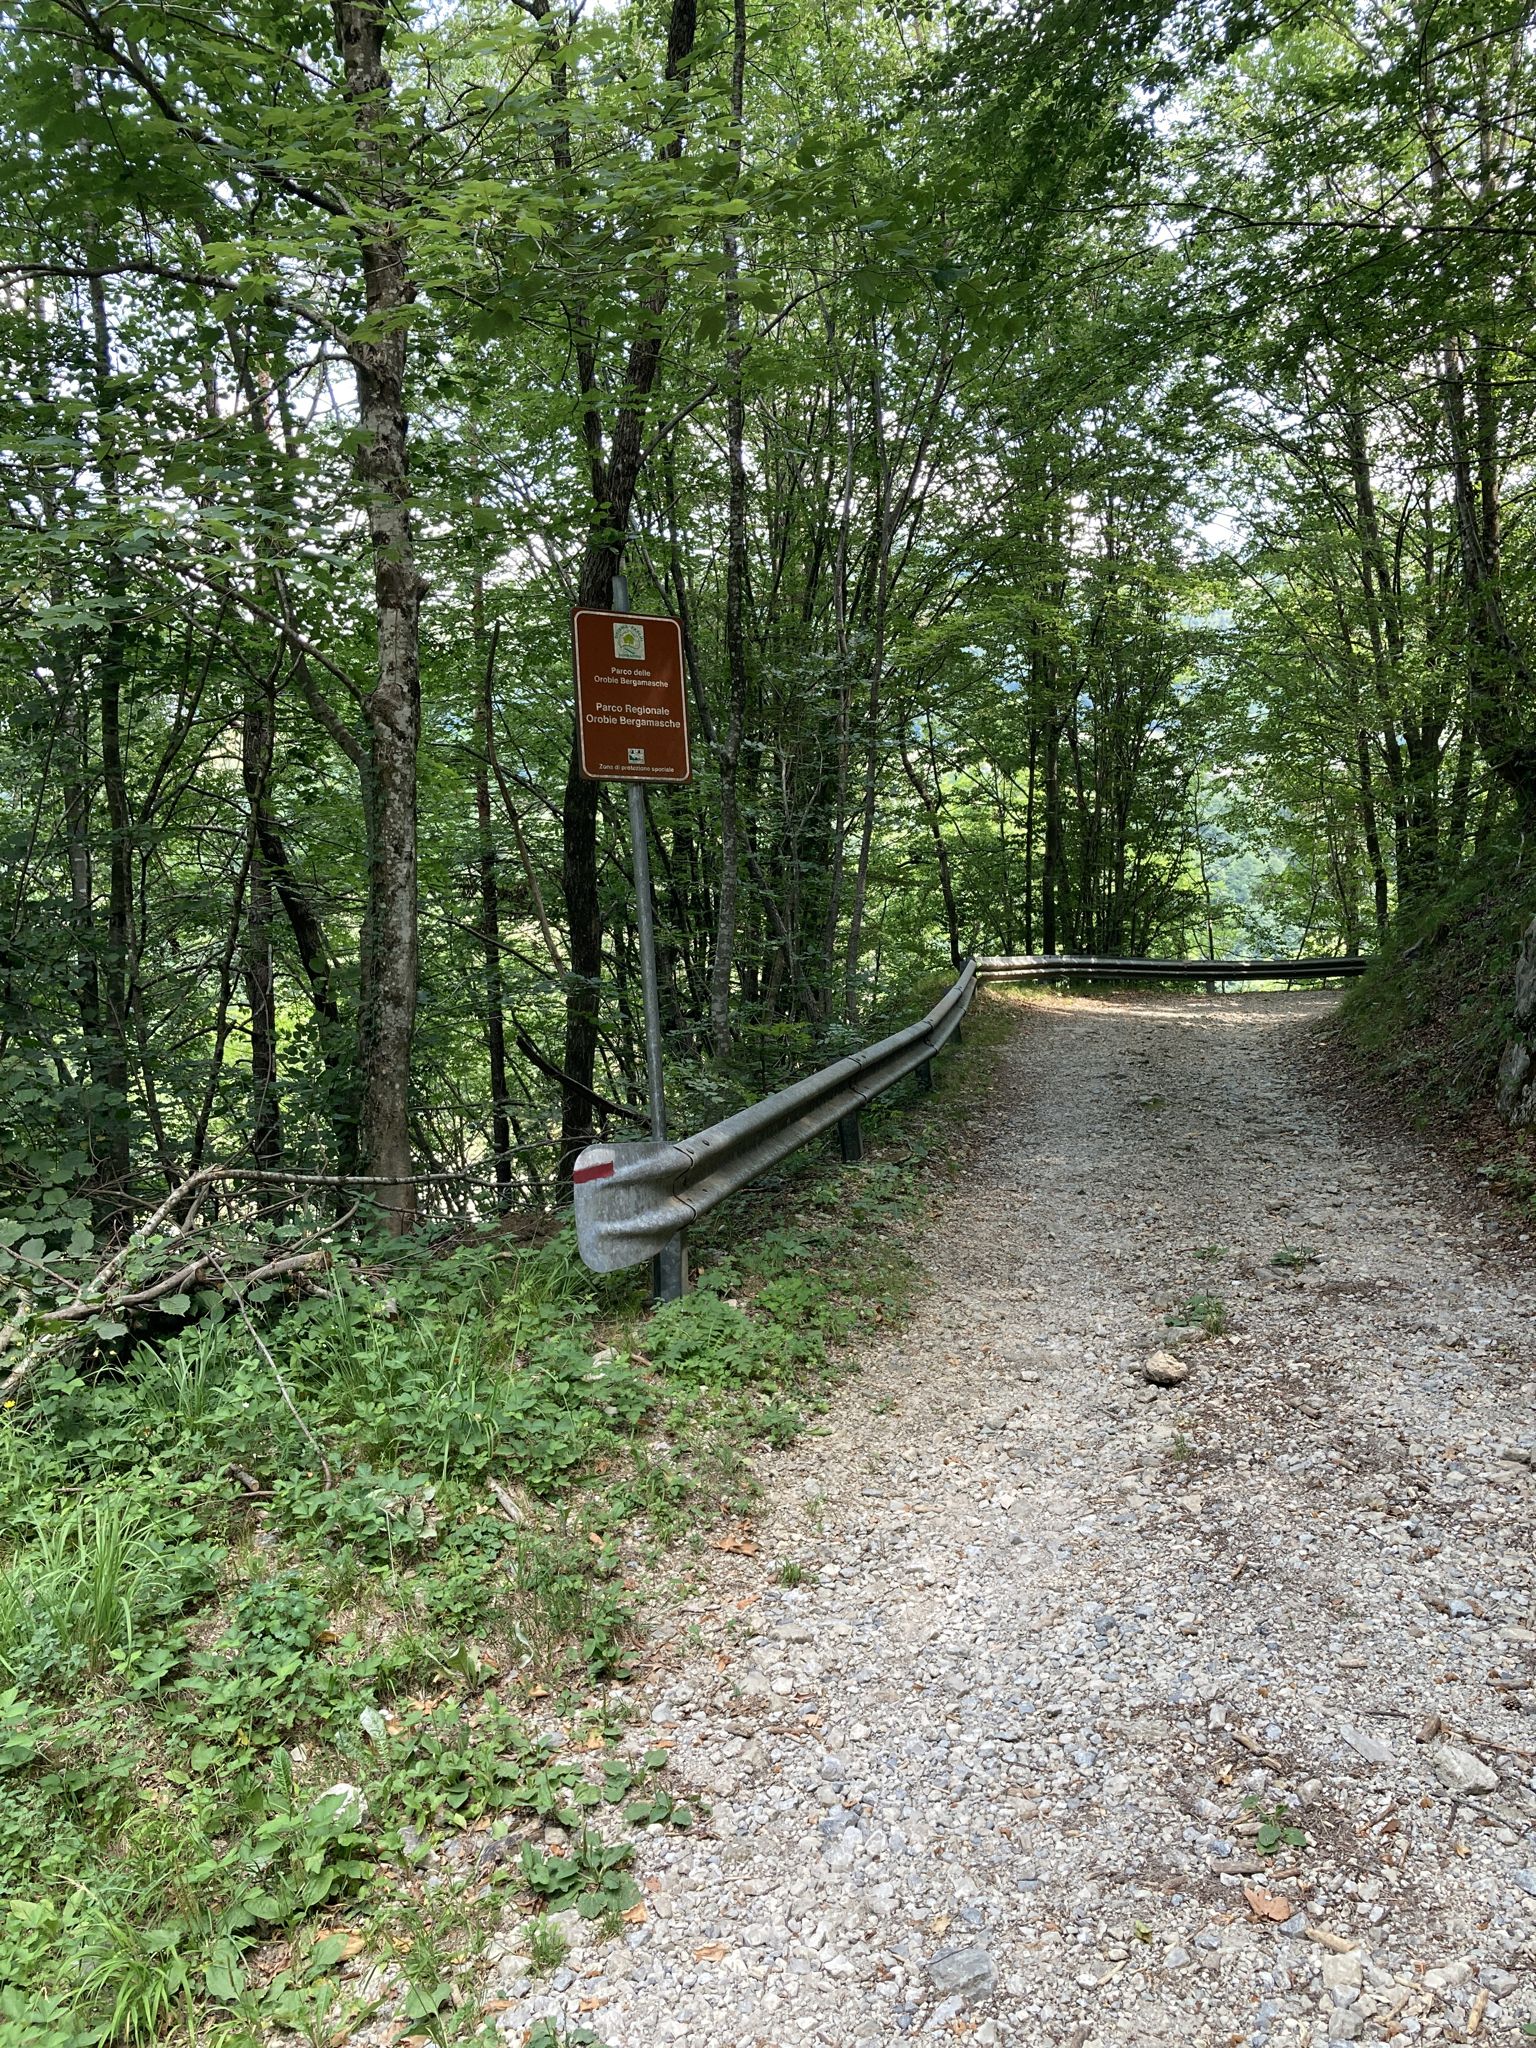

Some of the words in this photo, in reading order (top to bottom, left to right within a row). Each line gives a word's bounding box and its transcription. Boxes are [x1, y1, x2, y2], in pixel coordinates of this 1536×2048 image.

[611, 667, 632, 676] Parco
[633, 669, 651, 677] delle
[594, 675, 619, 684] Orobie
[620, 677, 669, 688] Bergamasche
[596, 702, 623, 713] Parco
[625, 704, 670, 716] Regionale
[586, 714, 618, 725] Orobie
[620, 716, 681, 728] Bergamasche
